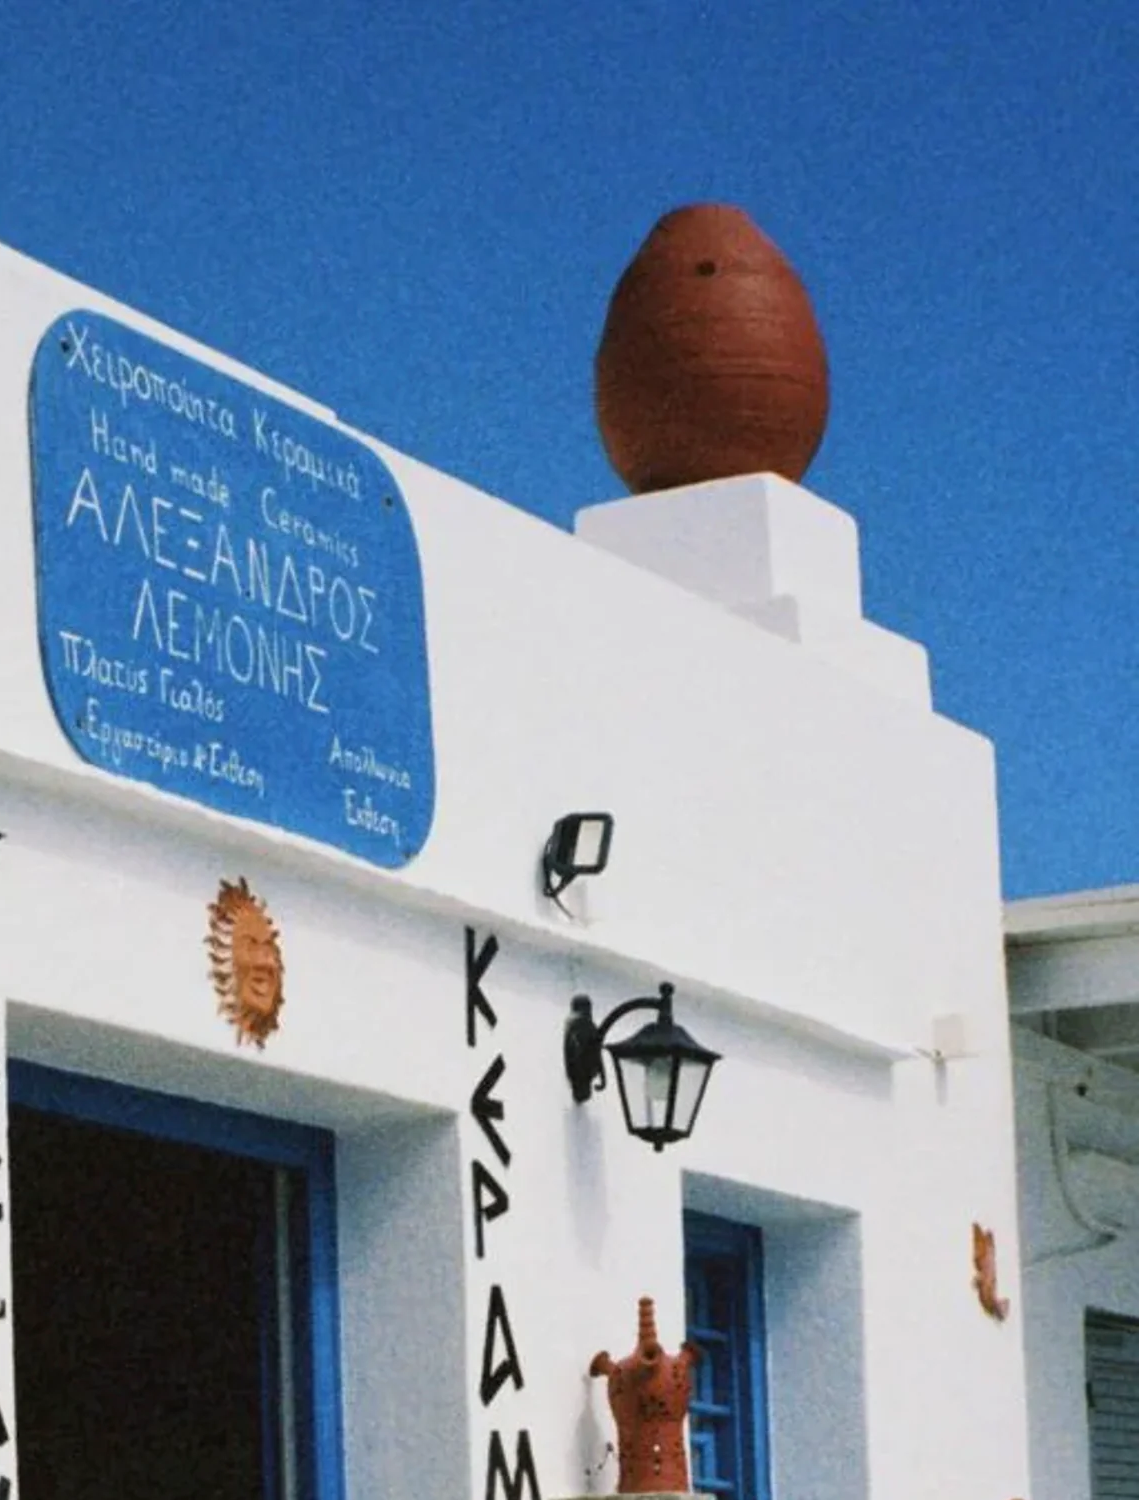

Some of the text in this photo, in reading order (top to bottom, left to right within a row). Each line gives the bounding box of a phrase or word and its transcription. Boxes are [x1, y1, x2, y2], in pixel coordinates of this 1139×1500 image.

[66, 467, 380, 655] ΑΛΕΞΑΝΔΡΟΣ
[90, 406, 360, 569] Hand made Ceramics
[131, 578, 331, 714] ΛΕΜΟΝΗΣ
